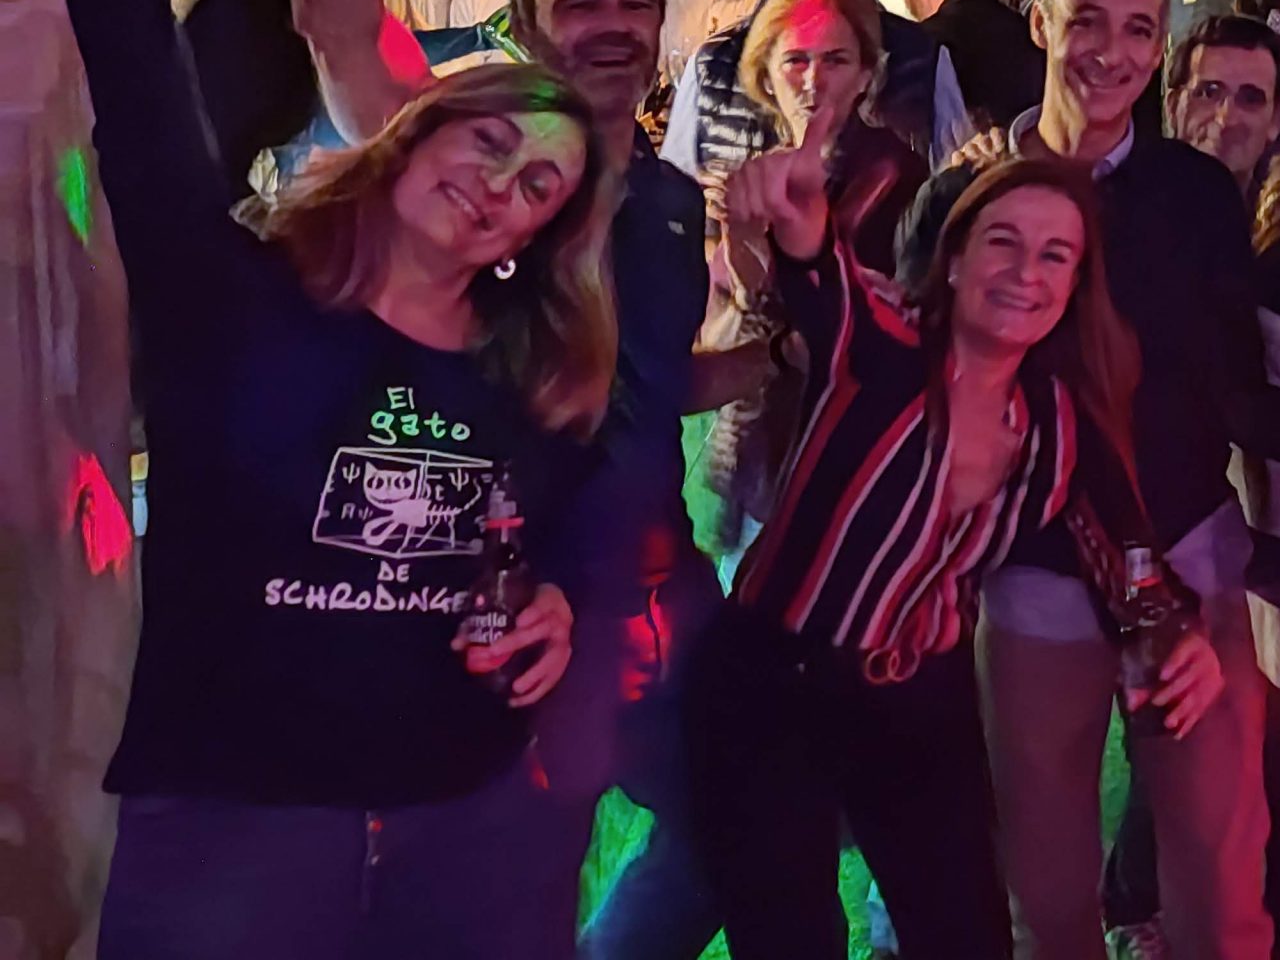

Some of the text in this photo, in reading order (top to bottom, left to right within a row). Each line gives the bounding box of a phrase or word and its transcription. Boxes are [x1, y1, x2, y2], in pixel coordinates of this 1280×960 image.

[386, 386, 415, 410] El
[367, 410, 471, 446] gato
[377, 560, 410, 583] DE
[264, 578, 470, 614] SCHRODINGE
